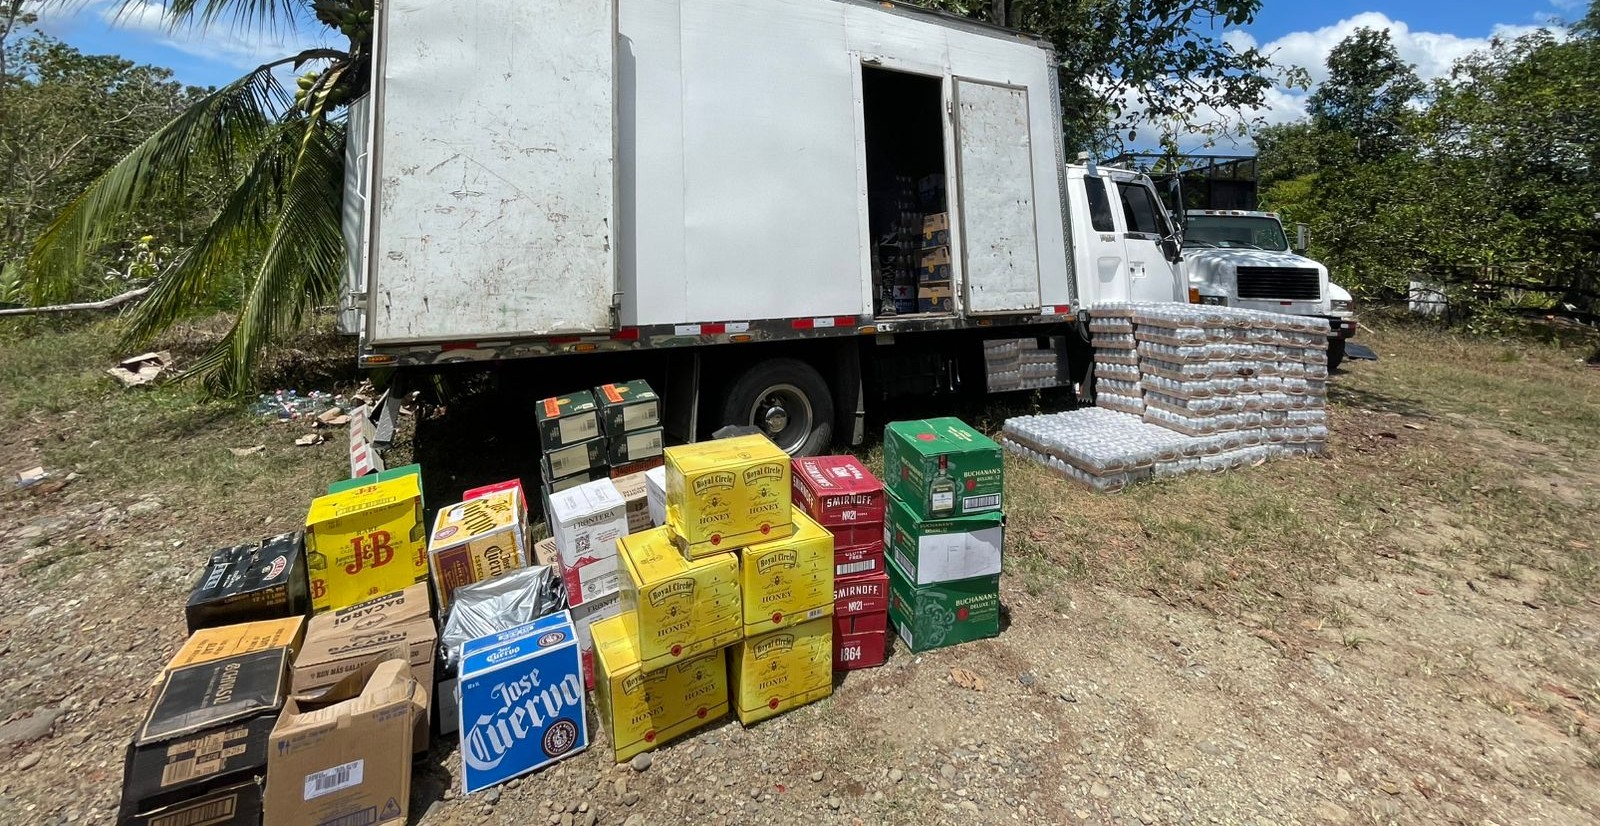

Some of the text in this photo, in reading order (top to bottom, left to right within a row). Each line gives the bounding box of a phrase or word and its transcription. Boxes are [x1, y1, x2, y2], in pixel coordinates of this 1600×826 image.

[746, 466, 781, 480] Royal Circle
[964, 468, 1001, 478] BUCHANAN'S
[696, 475, 733, 489] Royal Circle
[749, 502, 780, 515] HONEY
[573, 511, 615, 529] FRONTERA
[700, 512, 731, 525] HONEY
[345, 530, 394, 575] J&B
[760, 553, 794, 567] Royal Circle
[652, 580, 693, 600] Royal Circle
[762, 590, 792, 603] HONEY
[955, 593, 998, 607] BUCHANAN'S
[657, 620, 690, 637] HONEY
[757, 640, 773, 653] Royal
[841, 646, 861, 662] 1864
[486, 646, 520, 663] Cuervo
[490, 668, 541, 707] Jose
[760, 675, 789, 690] HONEY
[685, 683, 716, 701] HONEY
[464, 673, 582, 771] Cuervo
[631, 705, 664, 725] HONEY
